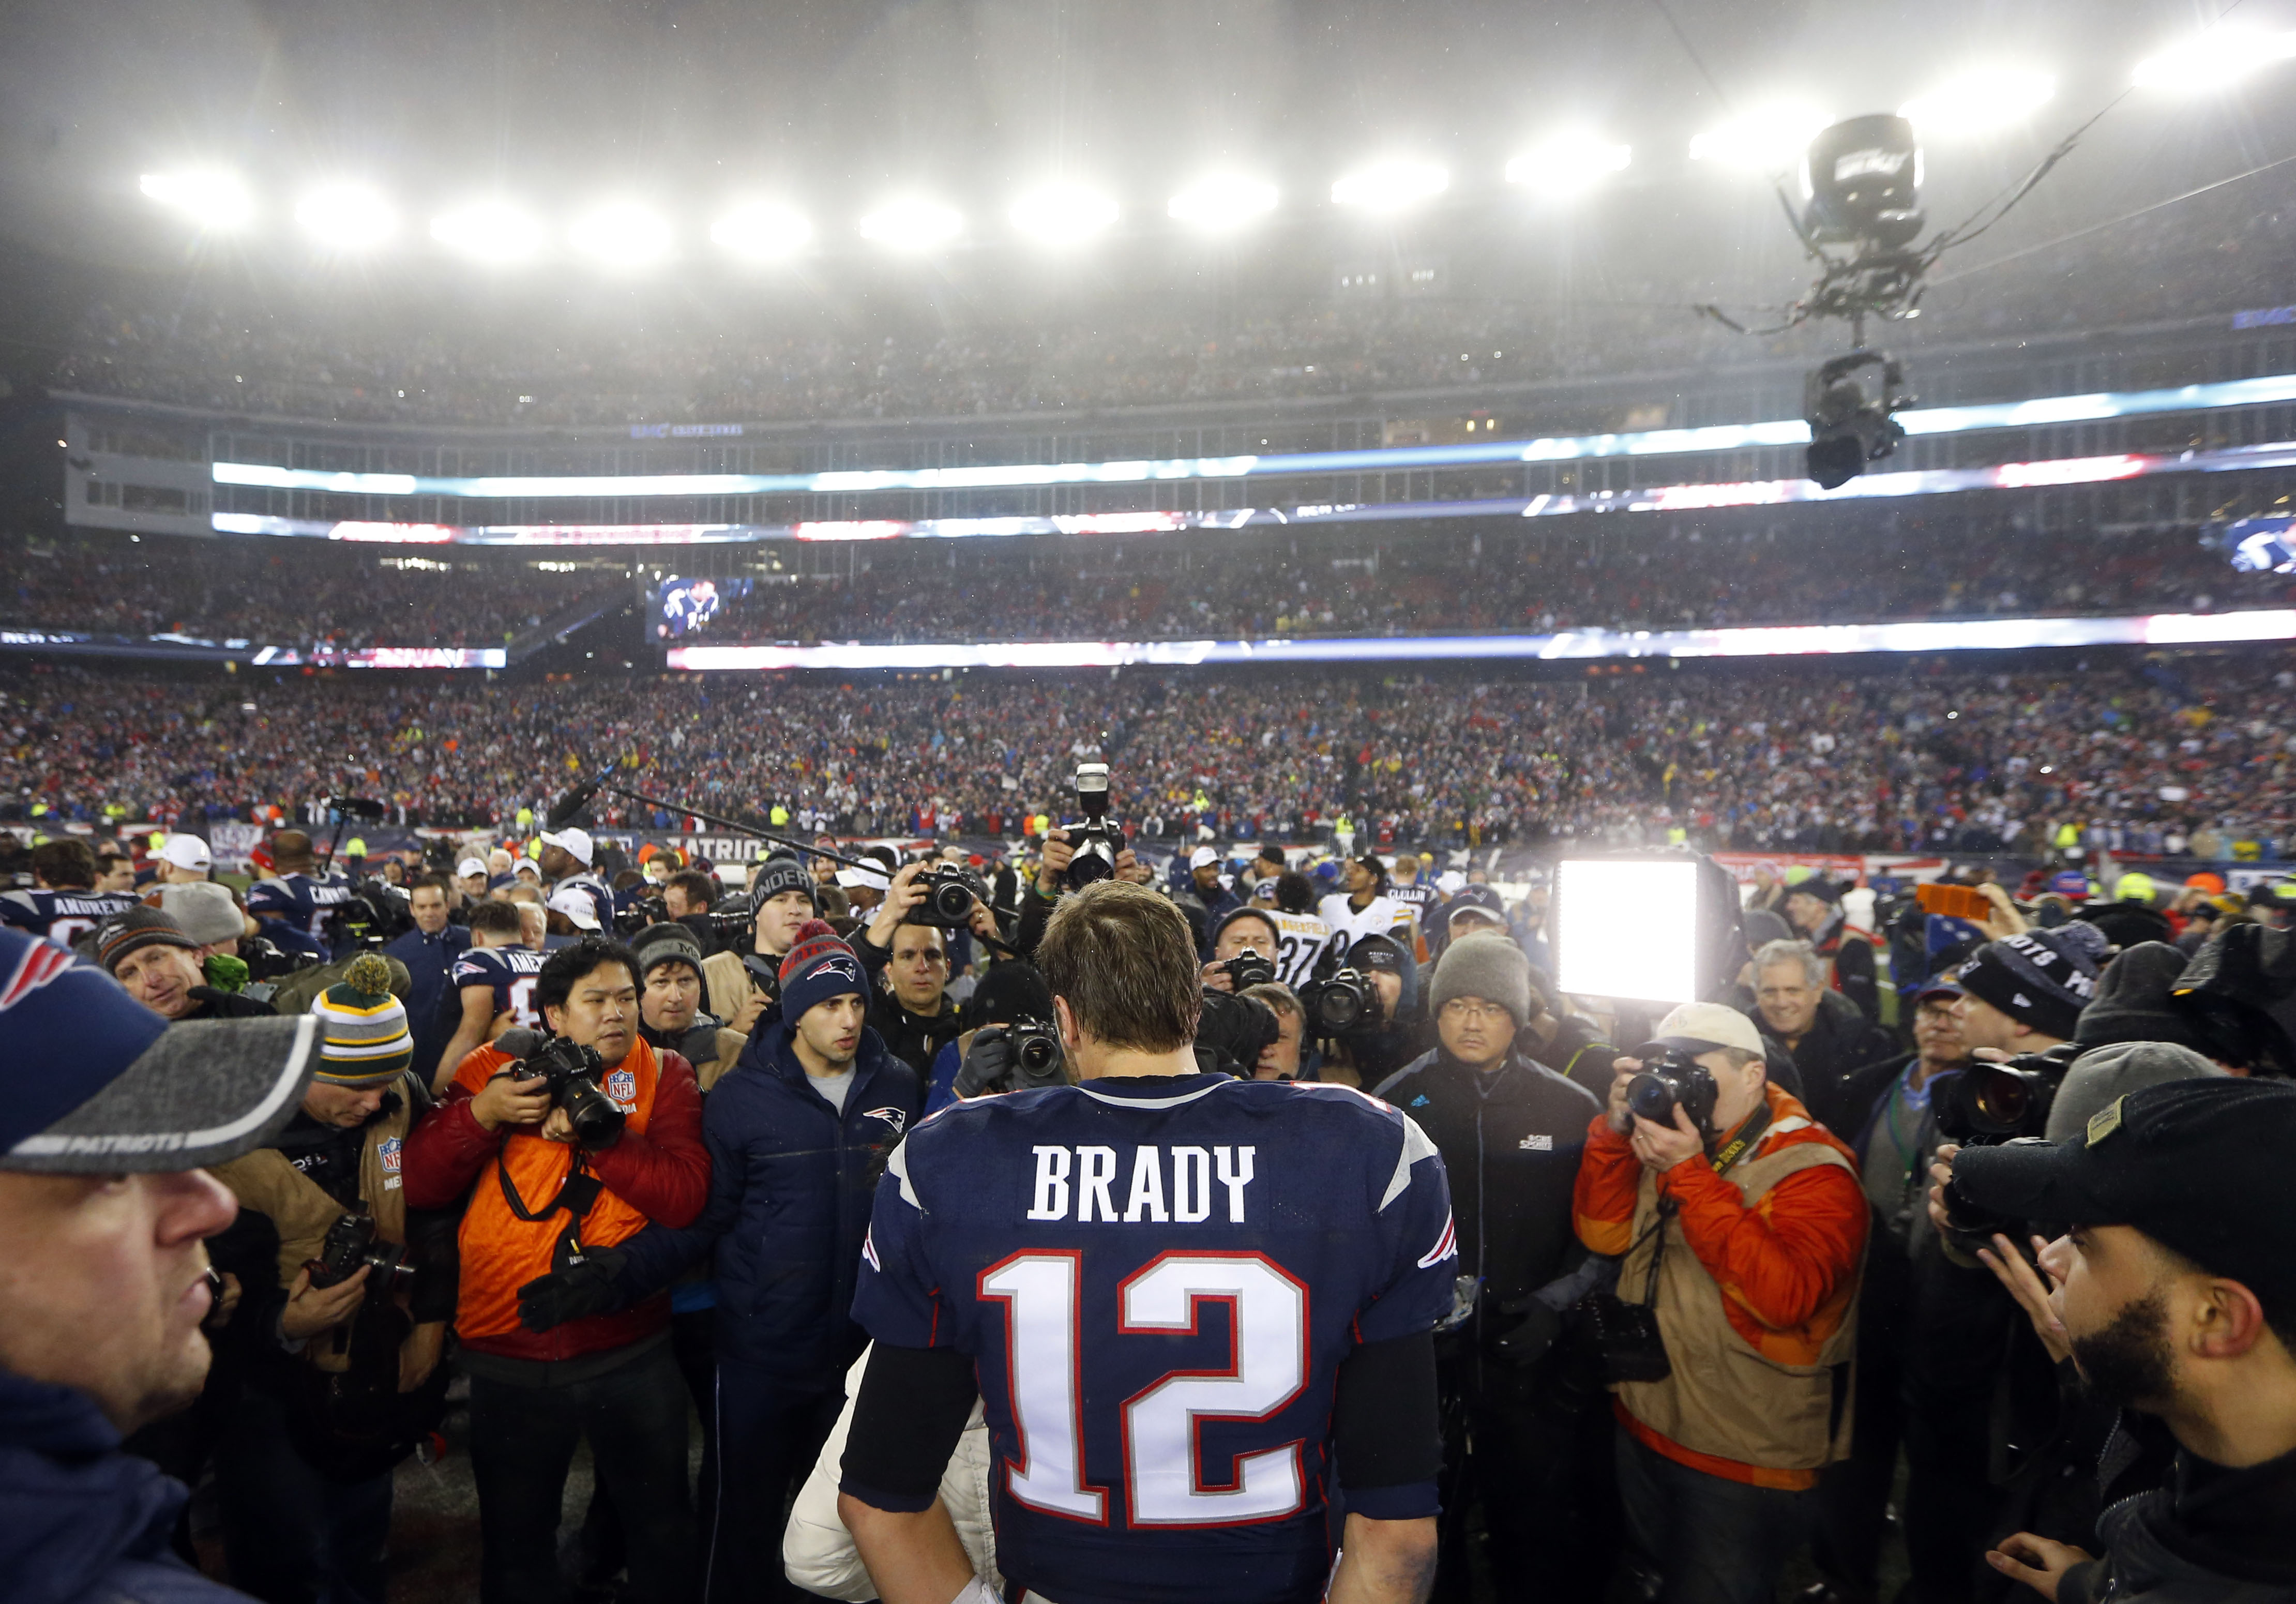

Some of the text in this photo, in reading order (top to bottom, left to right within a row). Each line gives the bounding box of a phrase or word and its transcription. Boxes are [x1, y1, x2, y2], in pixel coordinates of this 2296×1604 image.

[667, 838, 788, 860] ATRIO
[751, 869, 811, 907] UNDER
[1275, 936, 1321, 985] 37
[613, 1083, 632, 1097] NFL
[620, 1102, 637, 1115] DIA
[66, 1133, 183, 1155] PATRIOTS
[1519, 1140, 1553, 1151] SPORTS
[1027, 1145, 1257, 1223] BRADY
[976, 1247, 1310, 1530] 12
